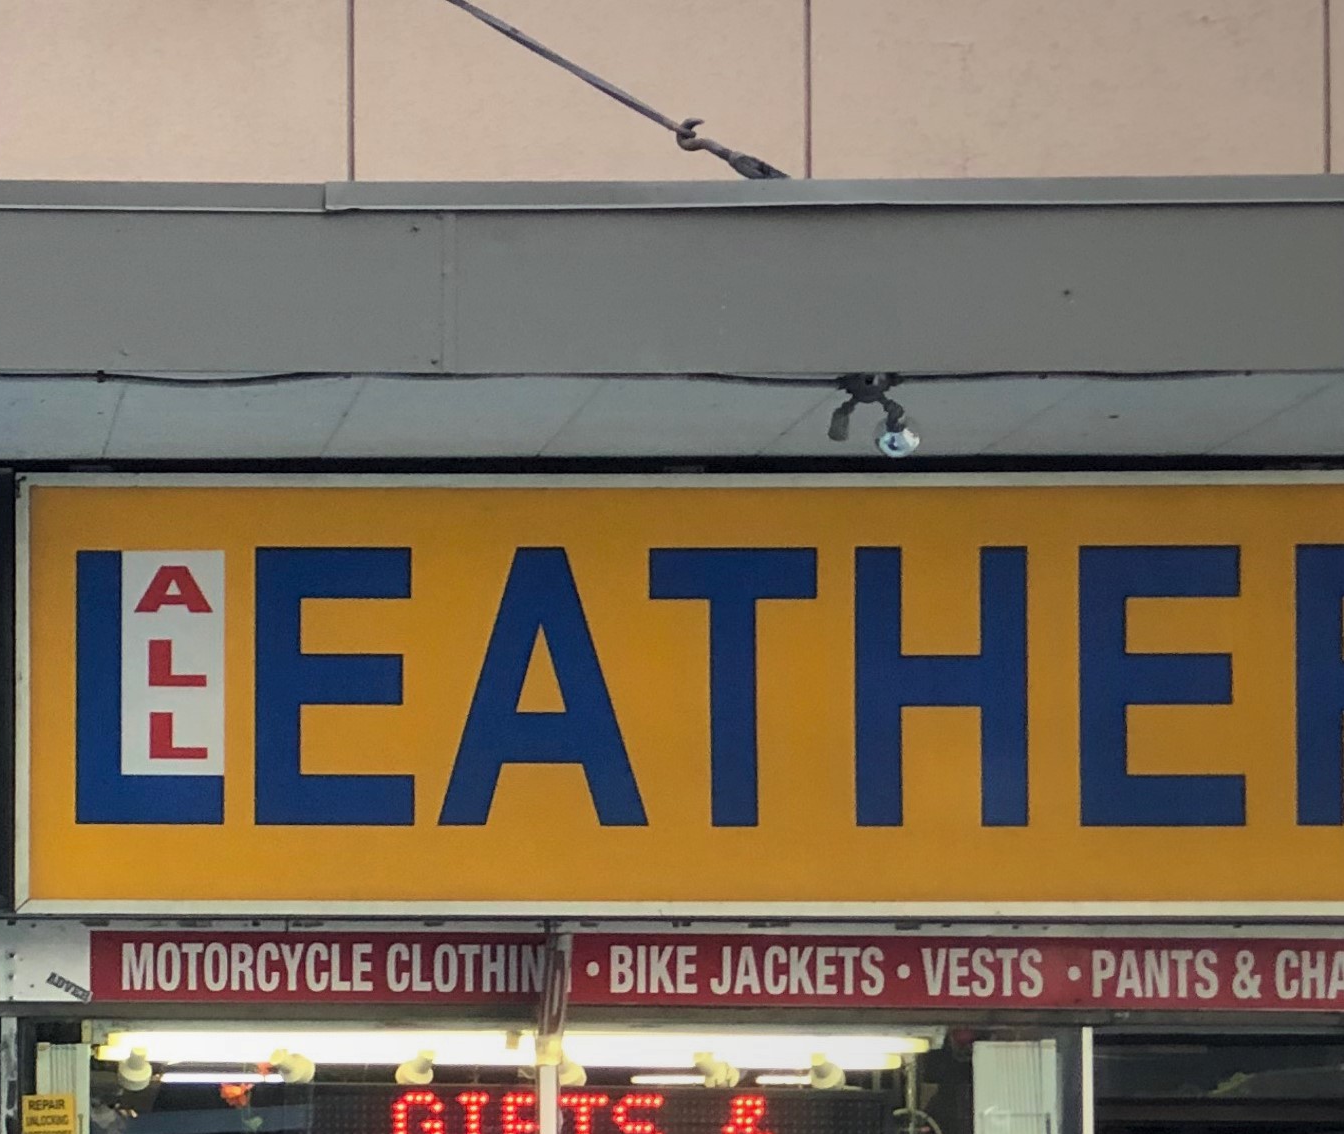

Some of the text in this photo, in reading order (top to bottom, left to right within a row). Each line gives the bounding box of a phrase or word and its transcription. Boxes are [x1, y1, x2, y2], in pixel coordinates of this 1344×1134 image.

[76, 543, 1344, 826] LEATHE
[134, 565, 213, 760] ALL
[121, 941, 374, 993] MOTORCYCLE
[386, 942, 571, 993] CLOTHIN
[610, 945, 698, 994] BIKE
[710, 945, 886, 996] JACKETS
[920, 947, 1043, 998] VESTS
[1091, 949, 1219, 999] PANTS
[1231, 949, 1262, 999] &
[28, 1099, 65, 1110] REPAIR
